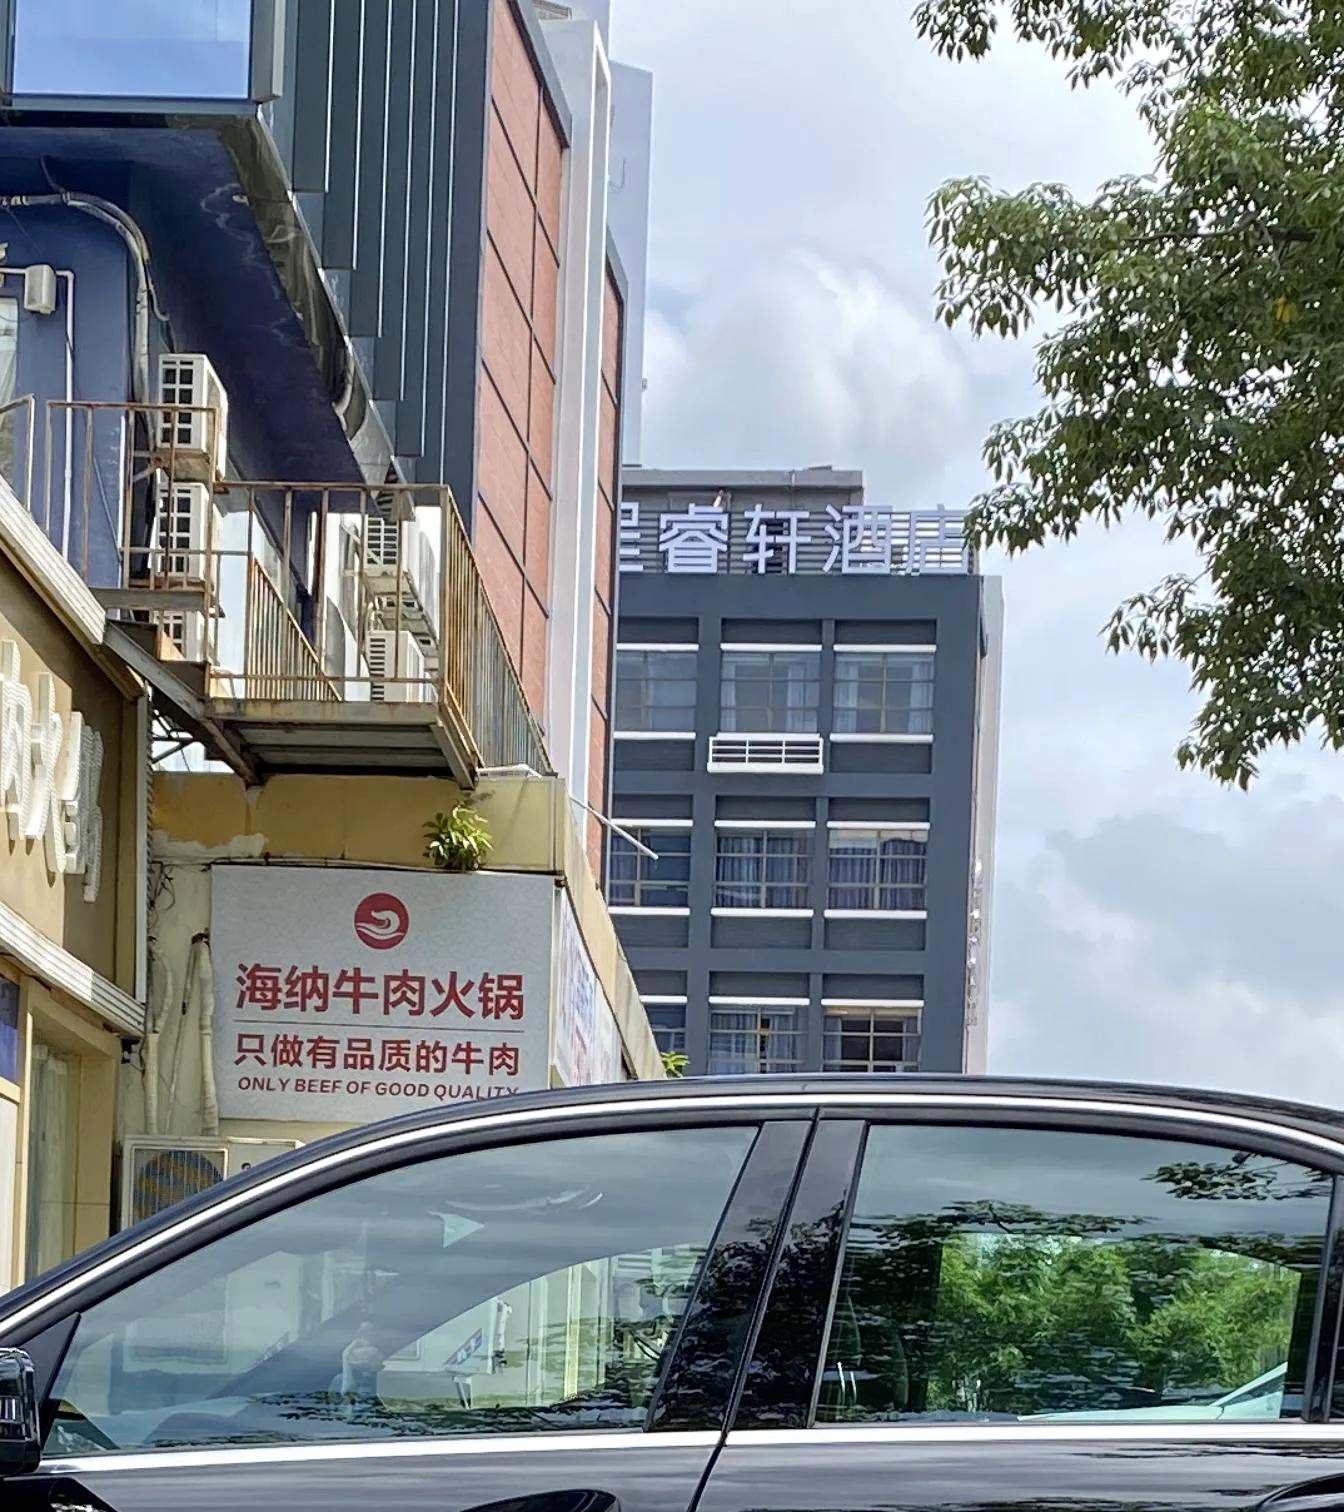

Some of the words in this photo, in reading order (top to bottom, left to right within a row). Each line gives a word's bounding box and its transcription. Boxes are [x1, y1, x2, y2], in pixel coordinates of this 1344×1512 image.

[235, 962, 525, 1021] 海纳牛肉火锅
[233, 1032, 520, 1076] 只做有品质的牛肉
[238, 1076, 290, 1092] ONLY
[295, 1078, 342, 1094] BEEF
[346, 1080, 371, 1095] OF
[375, 1082, 430, 1097] GOOD
